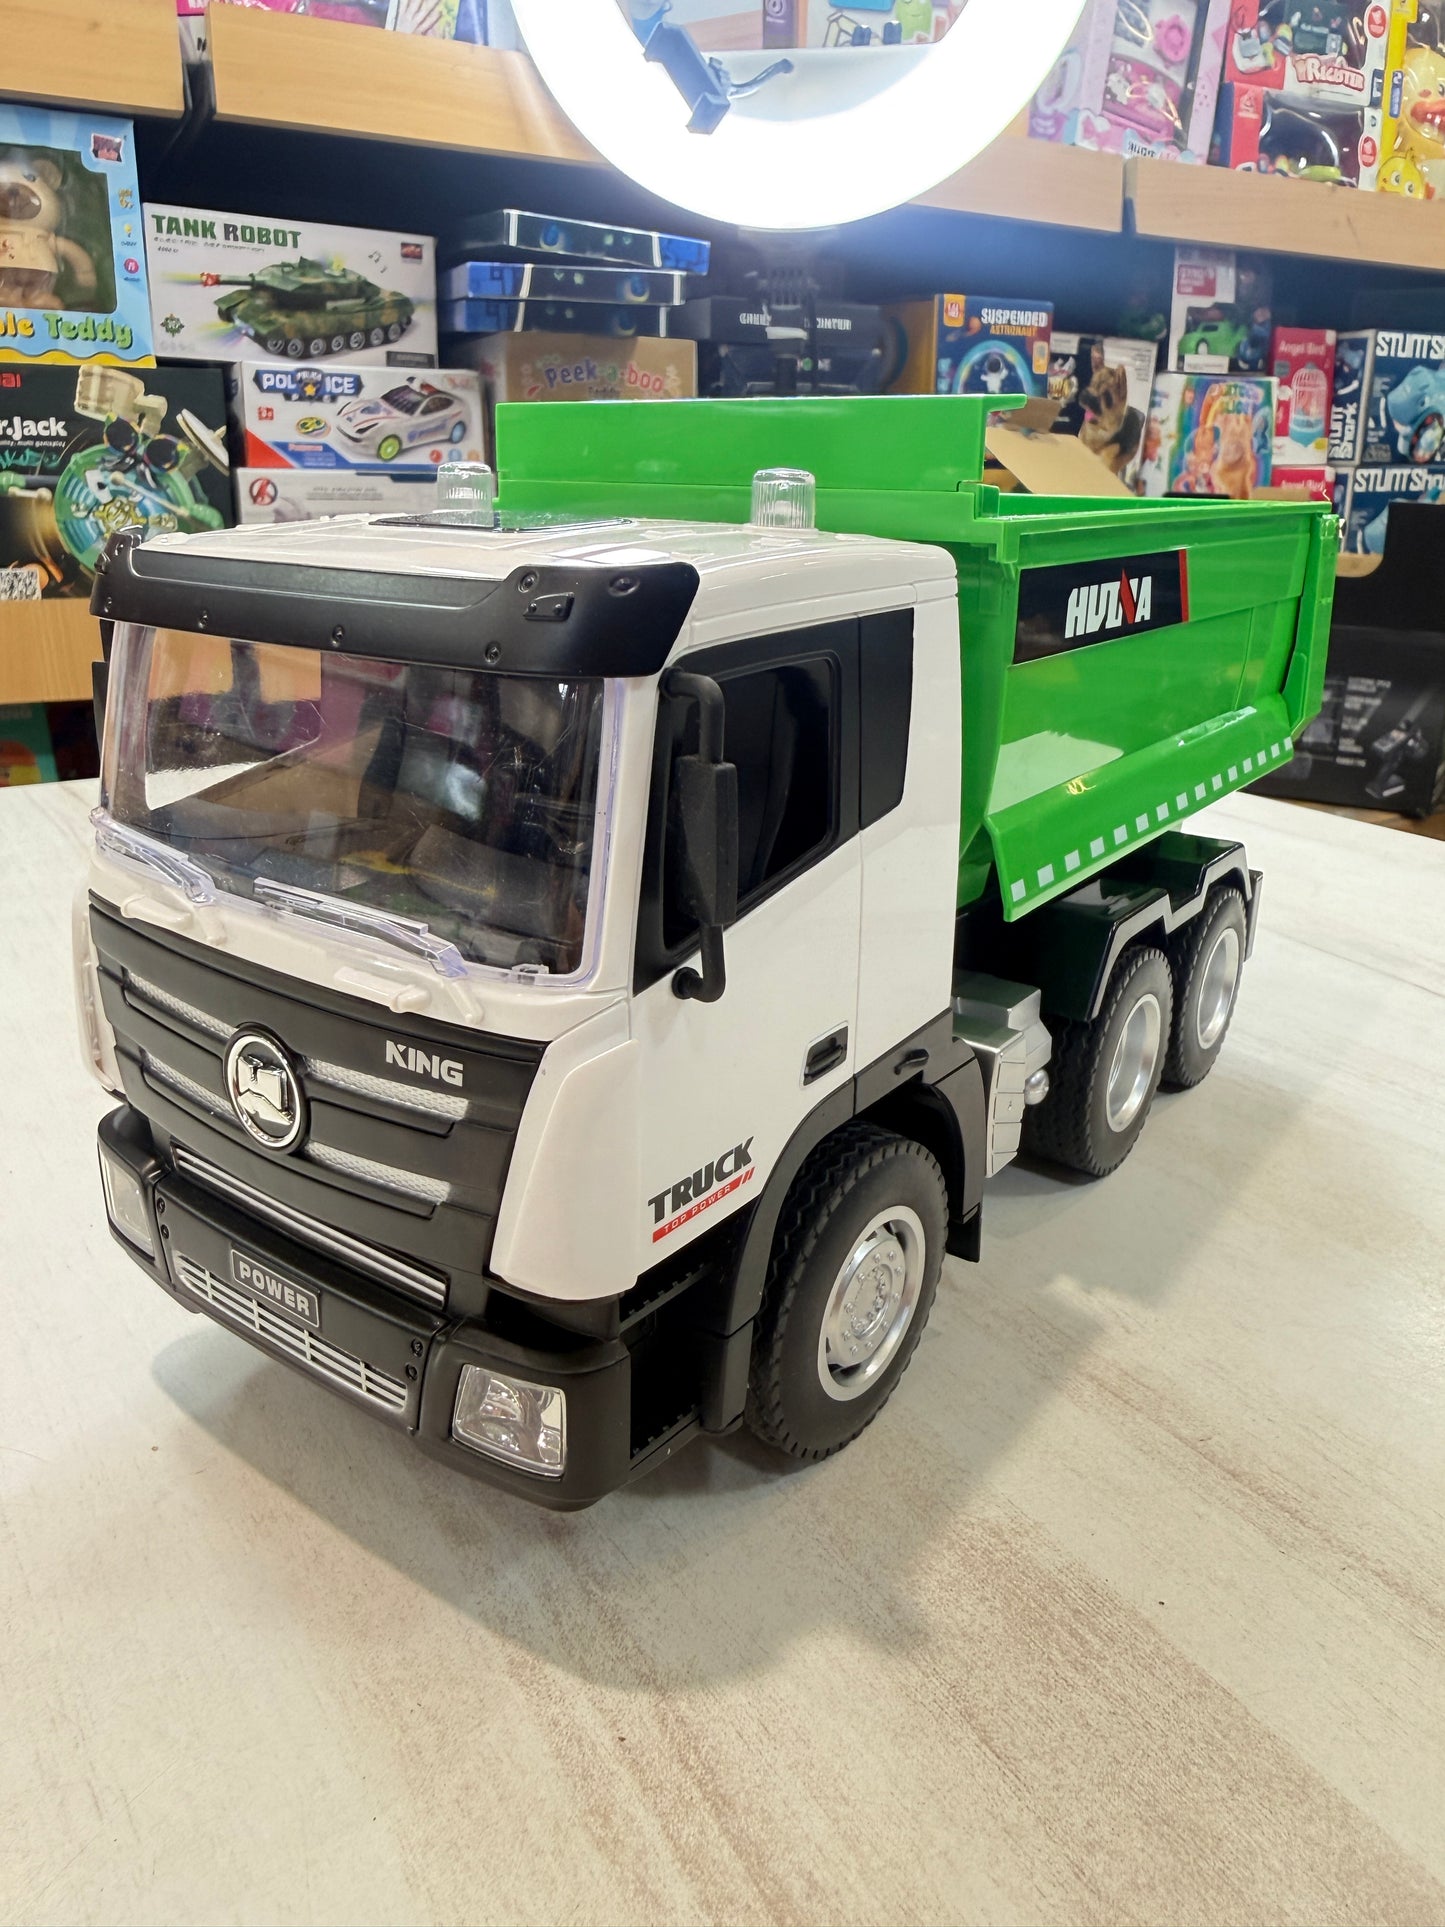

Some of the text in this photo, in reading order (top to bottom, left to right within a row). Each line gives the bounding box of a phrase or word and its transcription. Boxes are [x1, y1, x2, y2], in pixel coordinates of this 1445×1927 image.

[151, 214, 217, 240] TANK
[223, 223, 302, 248] ROBOT
[43, 313, 133, 349] Teddy
[981, 308, 1049, 327] SUSPENDED
[990, 324, 1037, 336] ASTRONAUT
[385, 1040, 463, 1087] KING
[647, 1136, 754, 1225] TRUCK
[664, 1185, 730, 1233] TOP POWER
[239, 1261, 310, 1316] POWER
